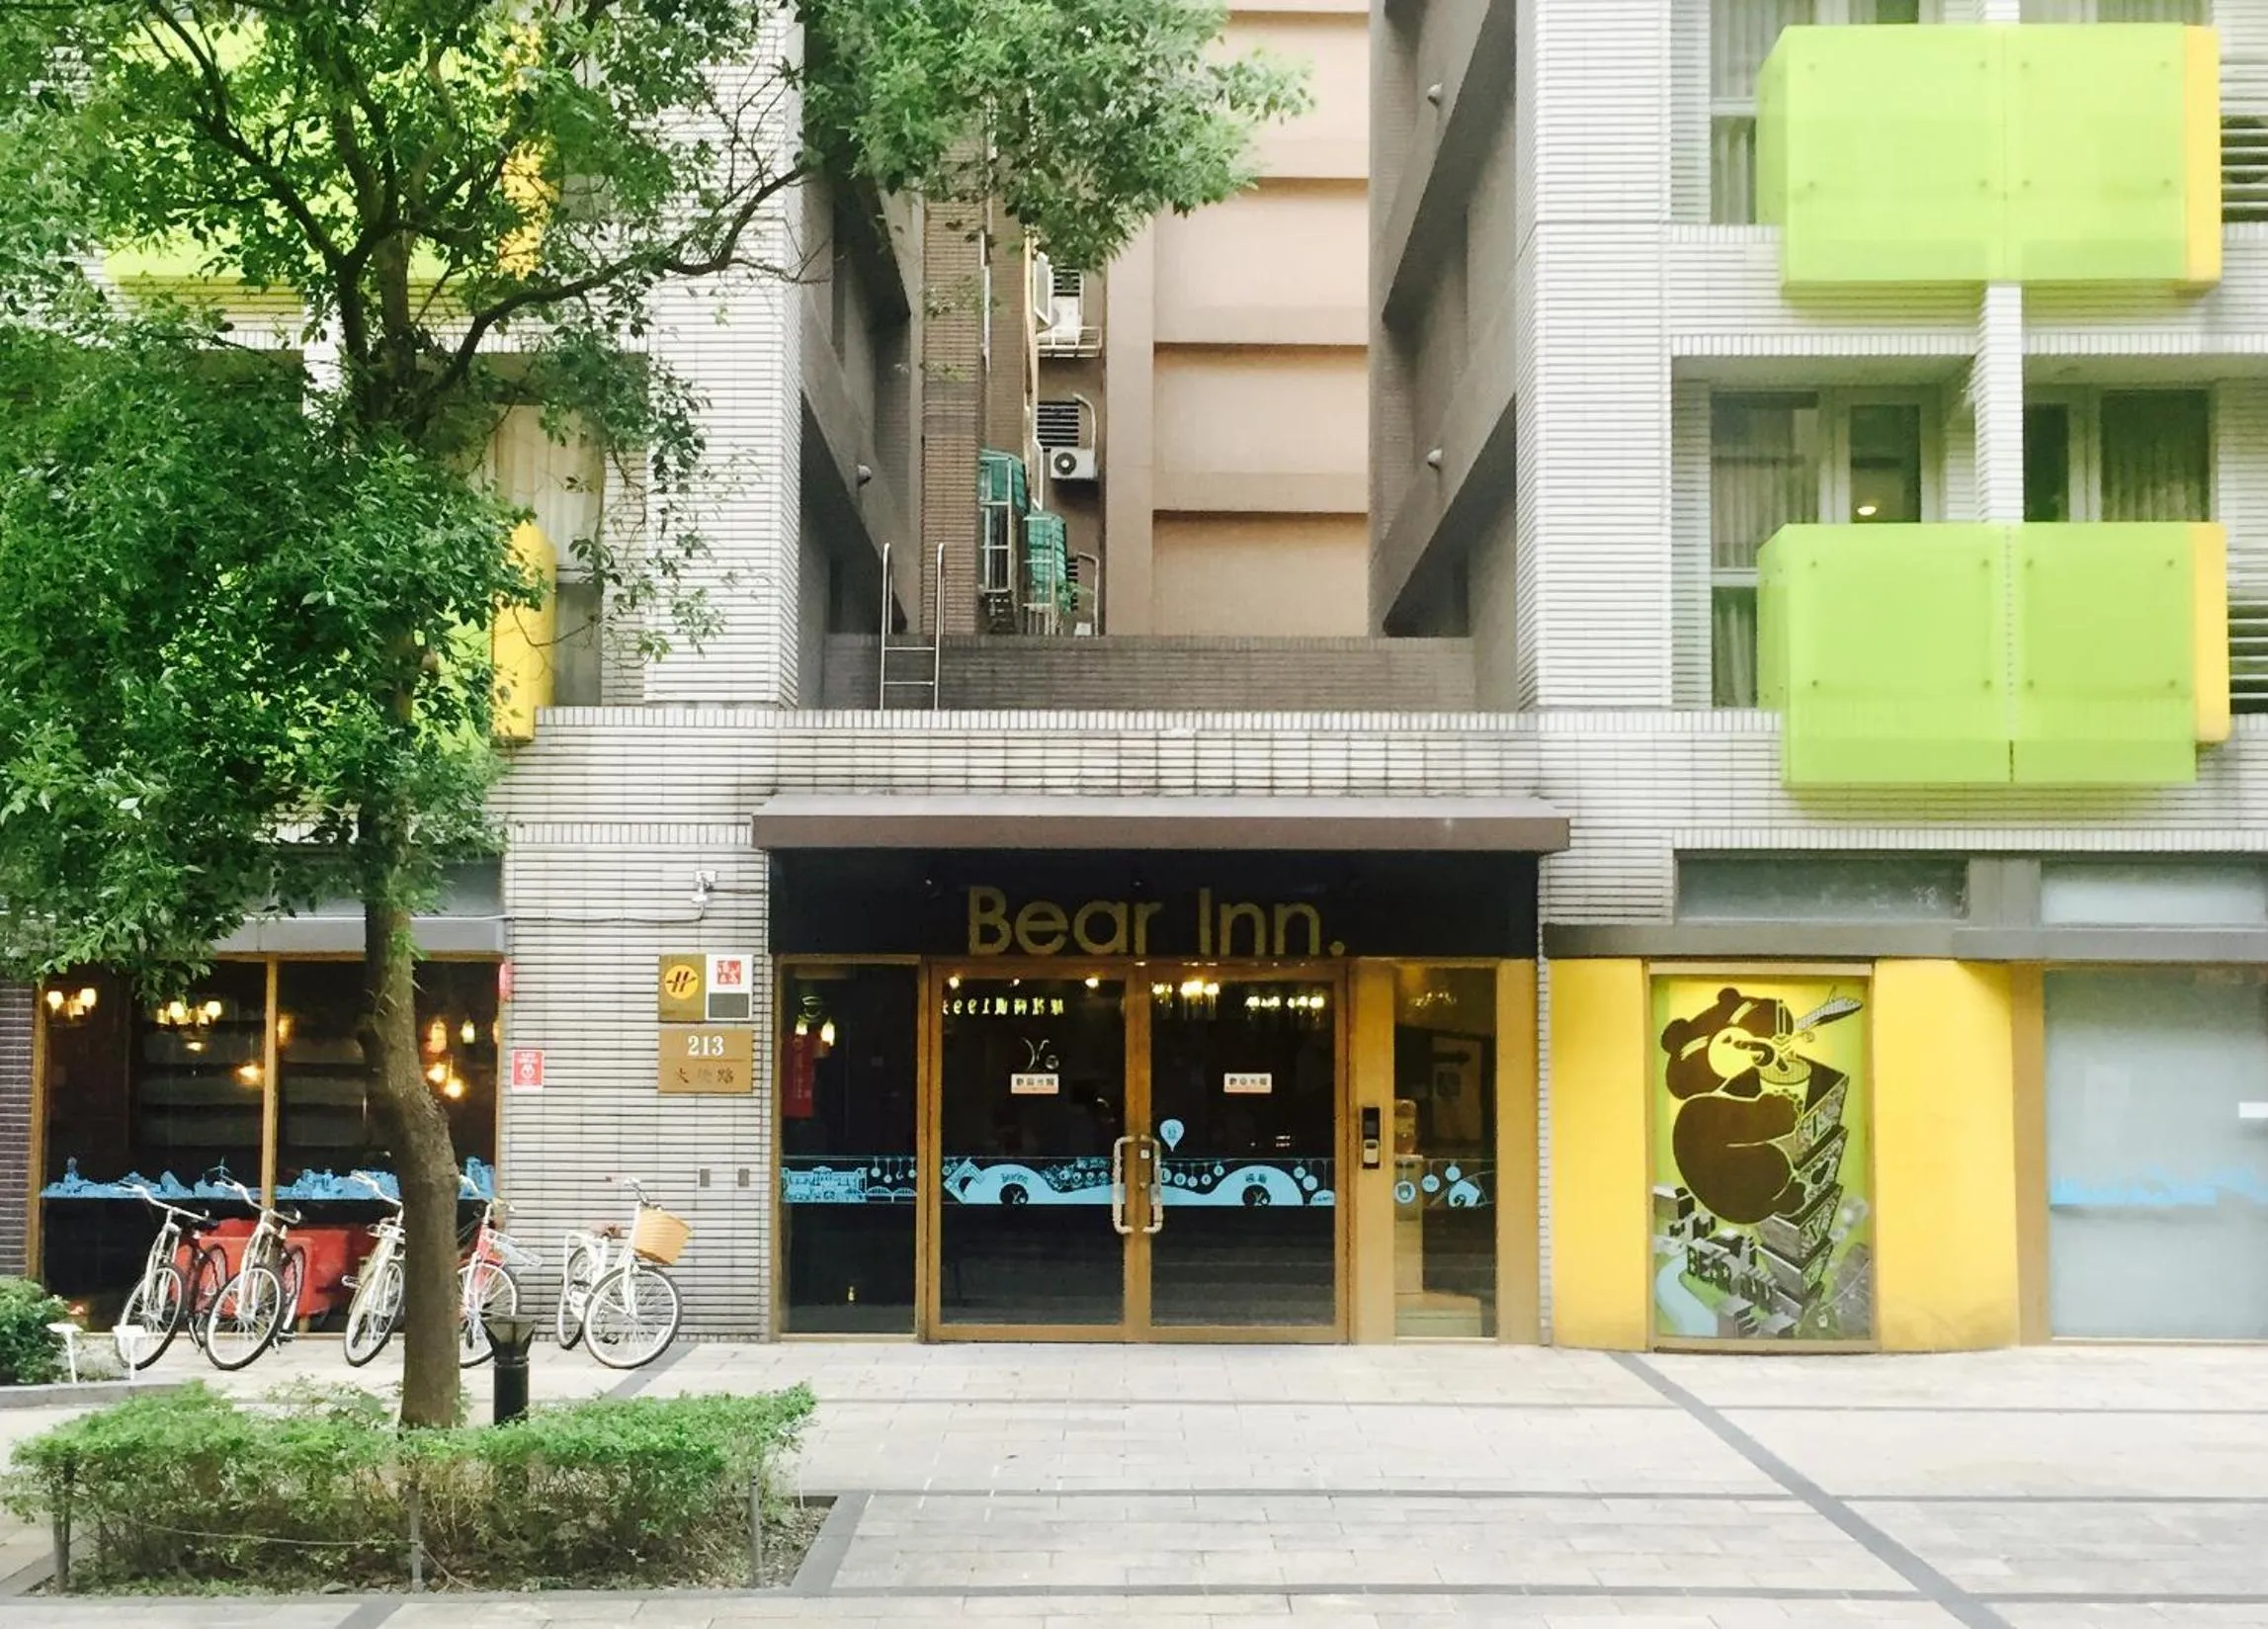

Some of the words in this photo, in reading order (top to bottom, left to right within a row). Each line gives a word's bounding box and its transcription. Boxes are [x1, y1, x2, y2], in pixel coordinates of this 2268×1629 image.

[968, 886, 1163, 956] Bear
[1199, 887, 1345, 956] Inn.
[687, 1035, 724, 1057] 213
